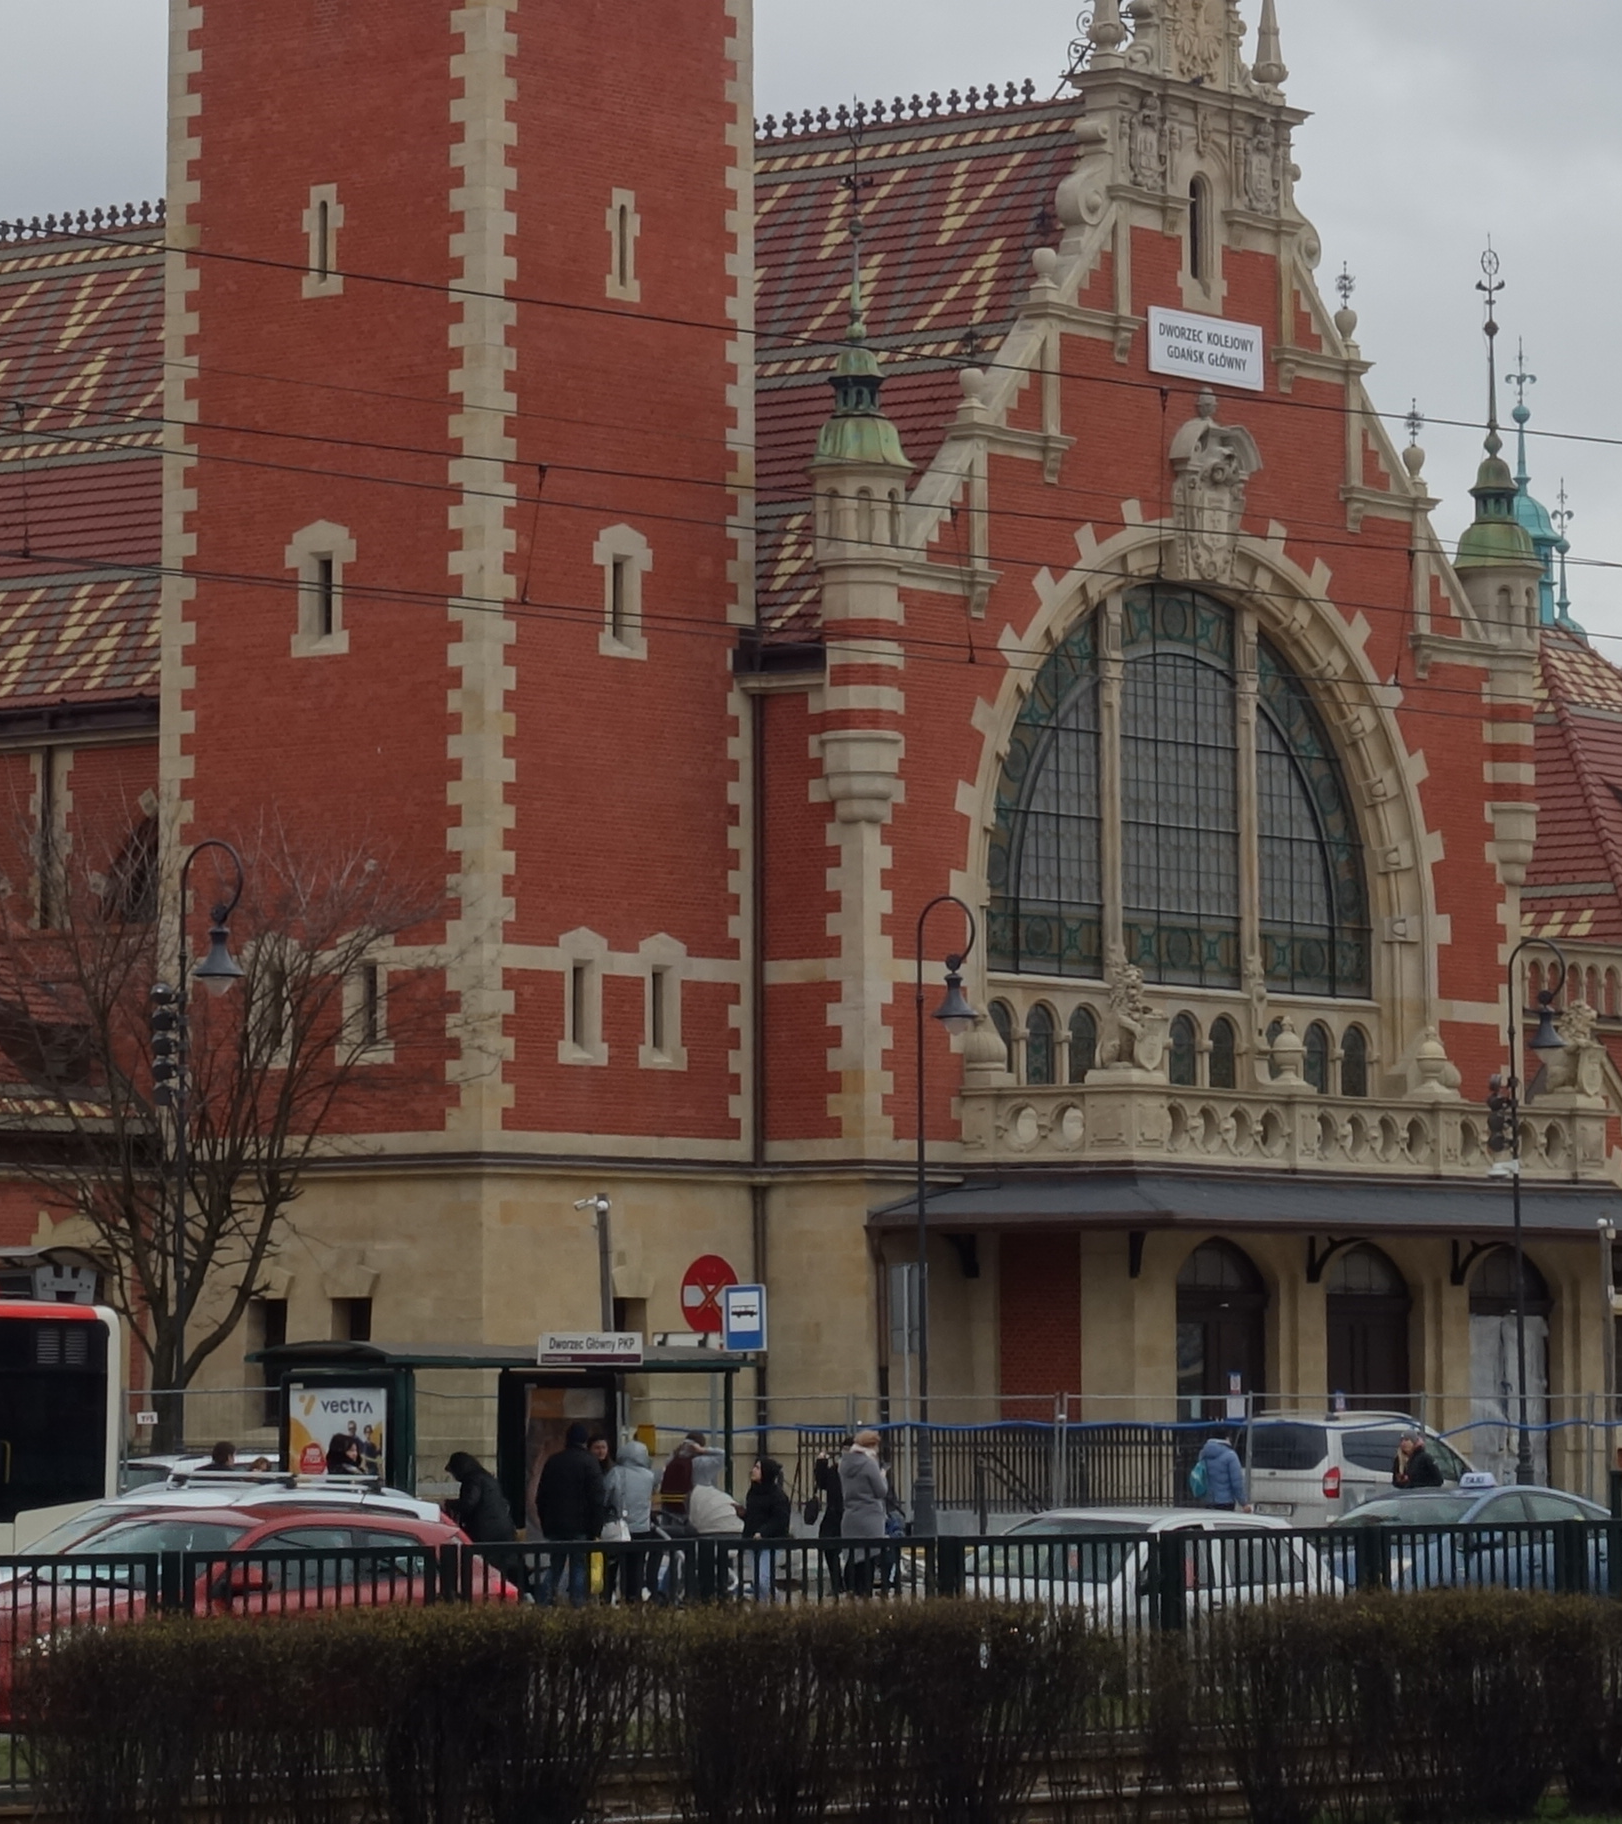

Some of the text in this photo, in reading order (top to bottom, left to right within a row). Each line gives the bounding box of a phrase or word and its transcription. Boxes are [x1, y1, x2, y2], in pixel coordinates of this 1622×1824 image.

[1159, 322, 1254, 353] DWORZEC KOLEJOWY
[1167, 344, 1247, 372] GDAŃSK GŁÓWNY
[549, 1336, 635, 1353] Dworzec Główny PKP
